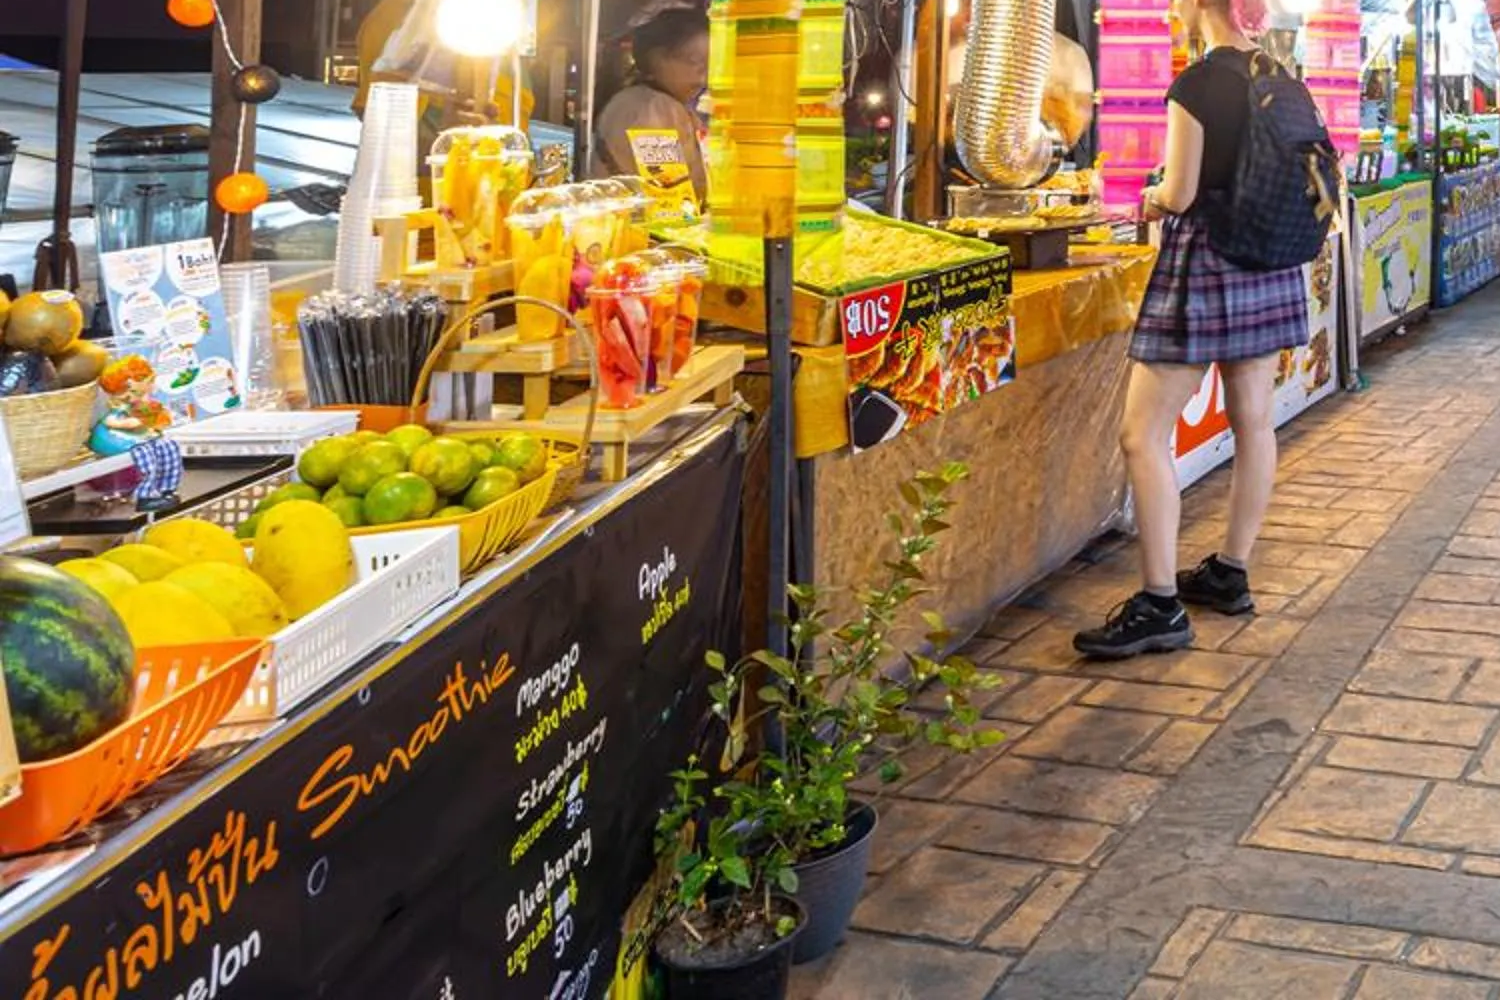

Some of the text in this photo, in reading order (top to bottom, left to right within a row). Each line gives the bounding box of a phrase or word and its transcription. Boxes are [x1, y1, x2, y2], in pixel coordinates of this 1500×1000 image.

[639, 546, 677, 600] Apple
[516, 642, 581, 718] Manggo
[298, 648, 516, 841] Smoothie
[515, 716, 608, 821] Strawberry
[566, 798, 583, 830] 50
[505, 828, 593, 942] Blueberry
[554, 914, 574, 960] 50
